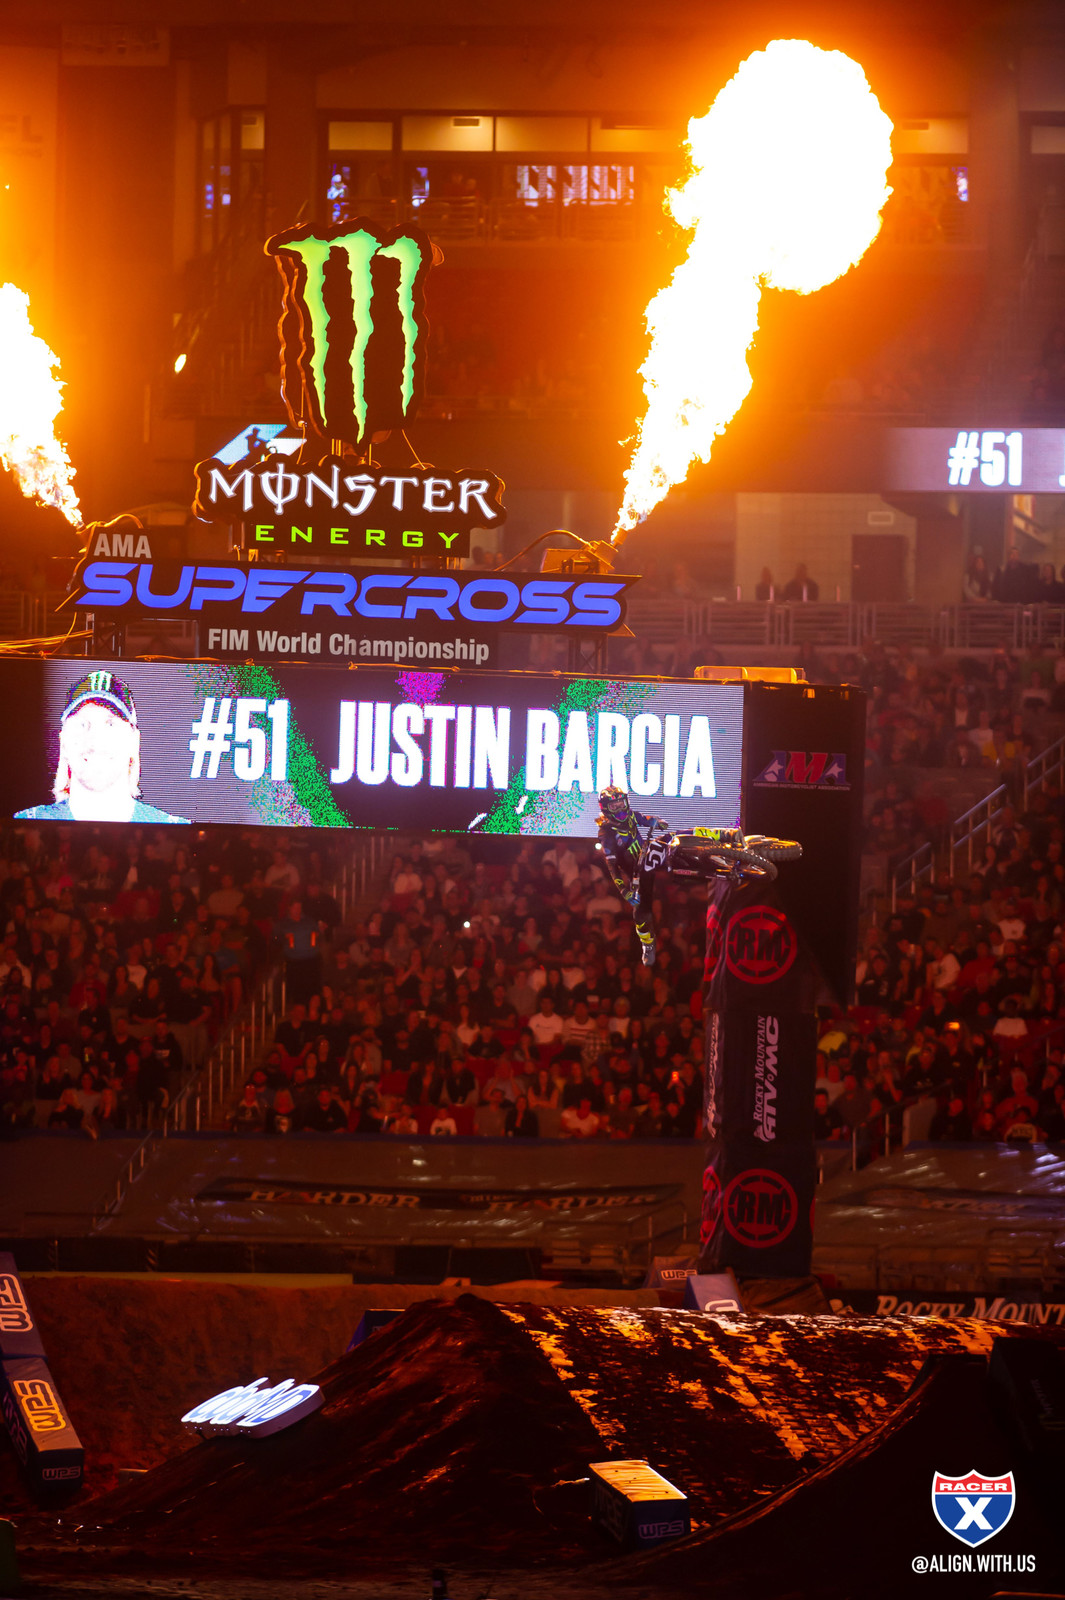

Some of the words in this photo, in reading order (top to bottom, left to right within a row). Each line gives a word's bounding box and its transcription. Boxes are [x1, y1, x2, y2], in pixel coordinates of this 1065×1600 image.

[948, 431, 1023, 487] #51
[208, 463, 497, 520] MONSTER
[93, 533, 152, 559] AMA
[255, 525, 459, 549] ENERGY
[75, 562, 626, 627] SUPERCROSS
[208, 628, 249, 651] FIM
[257, 630, 321, 655] World
[329, 633, 490, 665] Championship
[190, 697, 289, 782] #51
[330, 700, 511, 790] JUSTIN
[525, 708, 717, 798] BARCIA
[752, 750, 852, 785] AMA
[737, 927, 784, 961] RM
[755, 1016, 765, 1081] MOUNTAIN
[753, 1082, 764, 1121] ROCKY
[737, 1190, 784, 1224] RM
[42, 1467, 81, 1480] WPS
[639, 1520, 684, 1540] WPS
